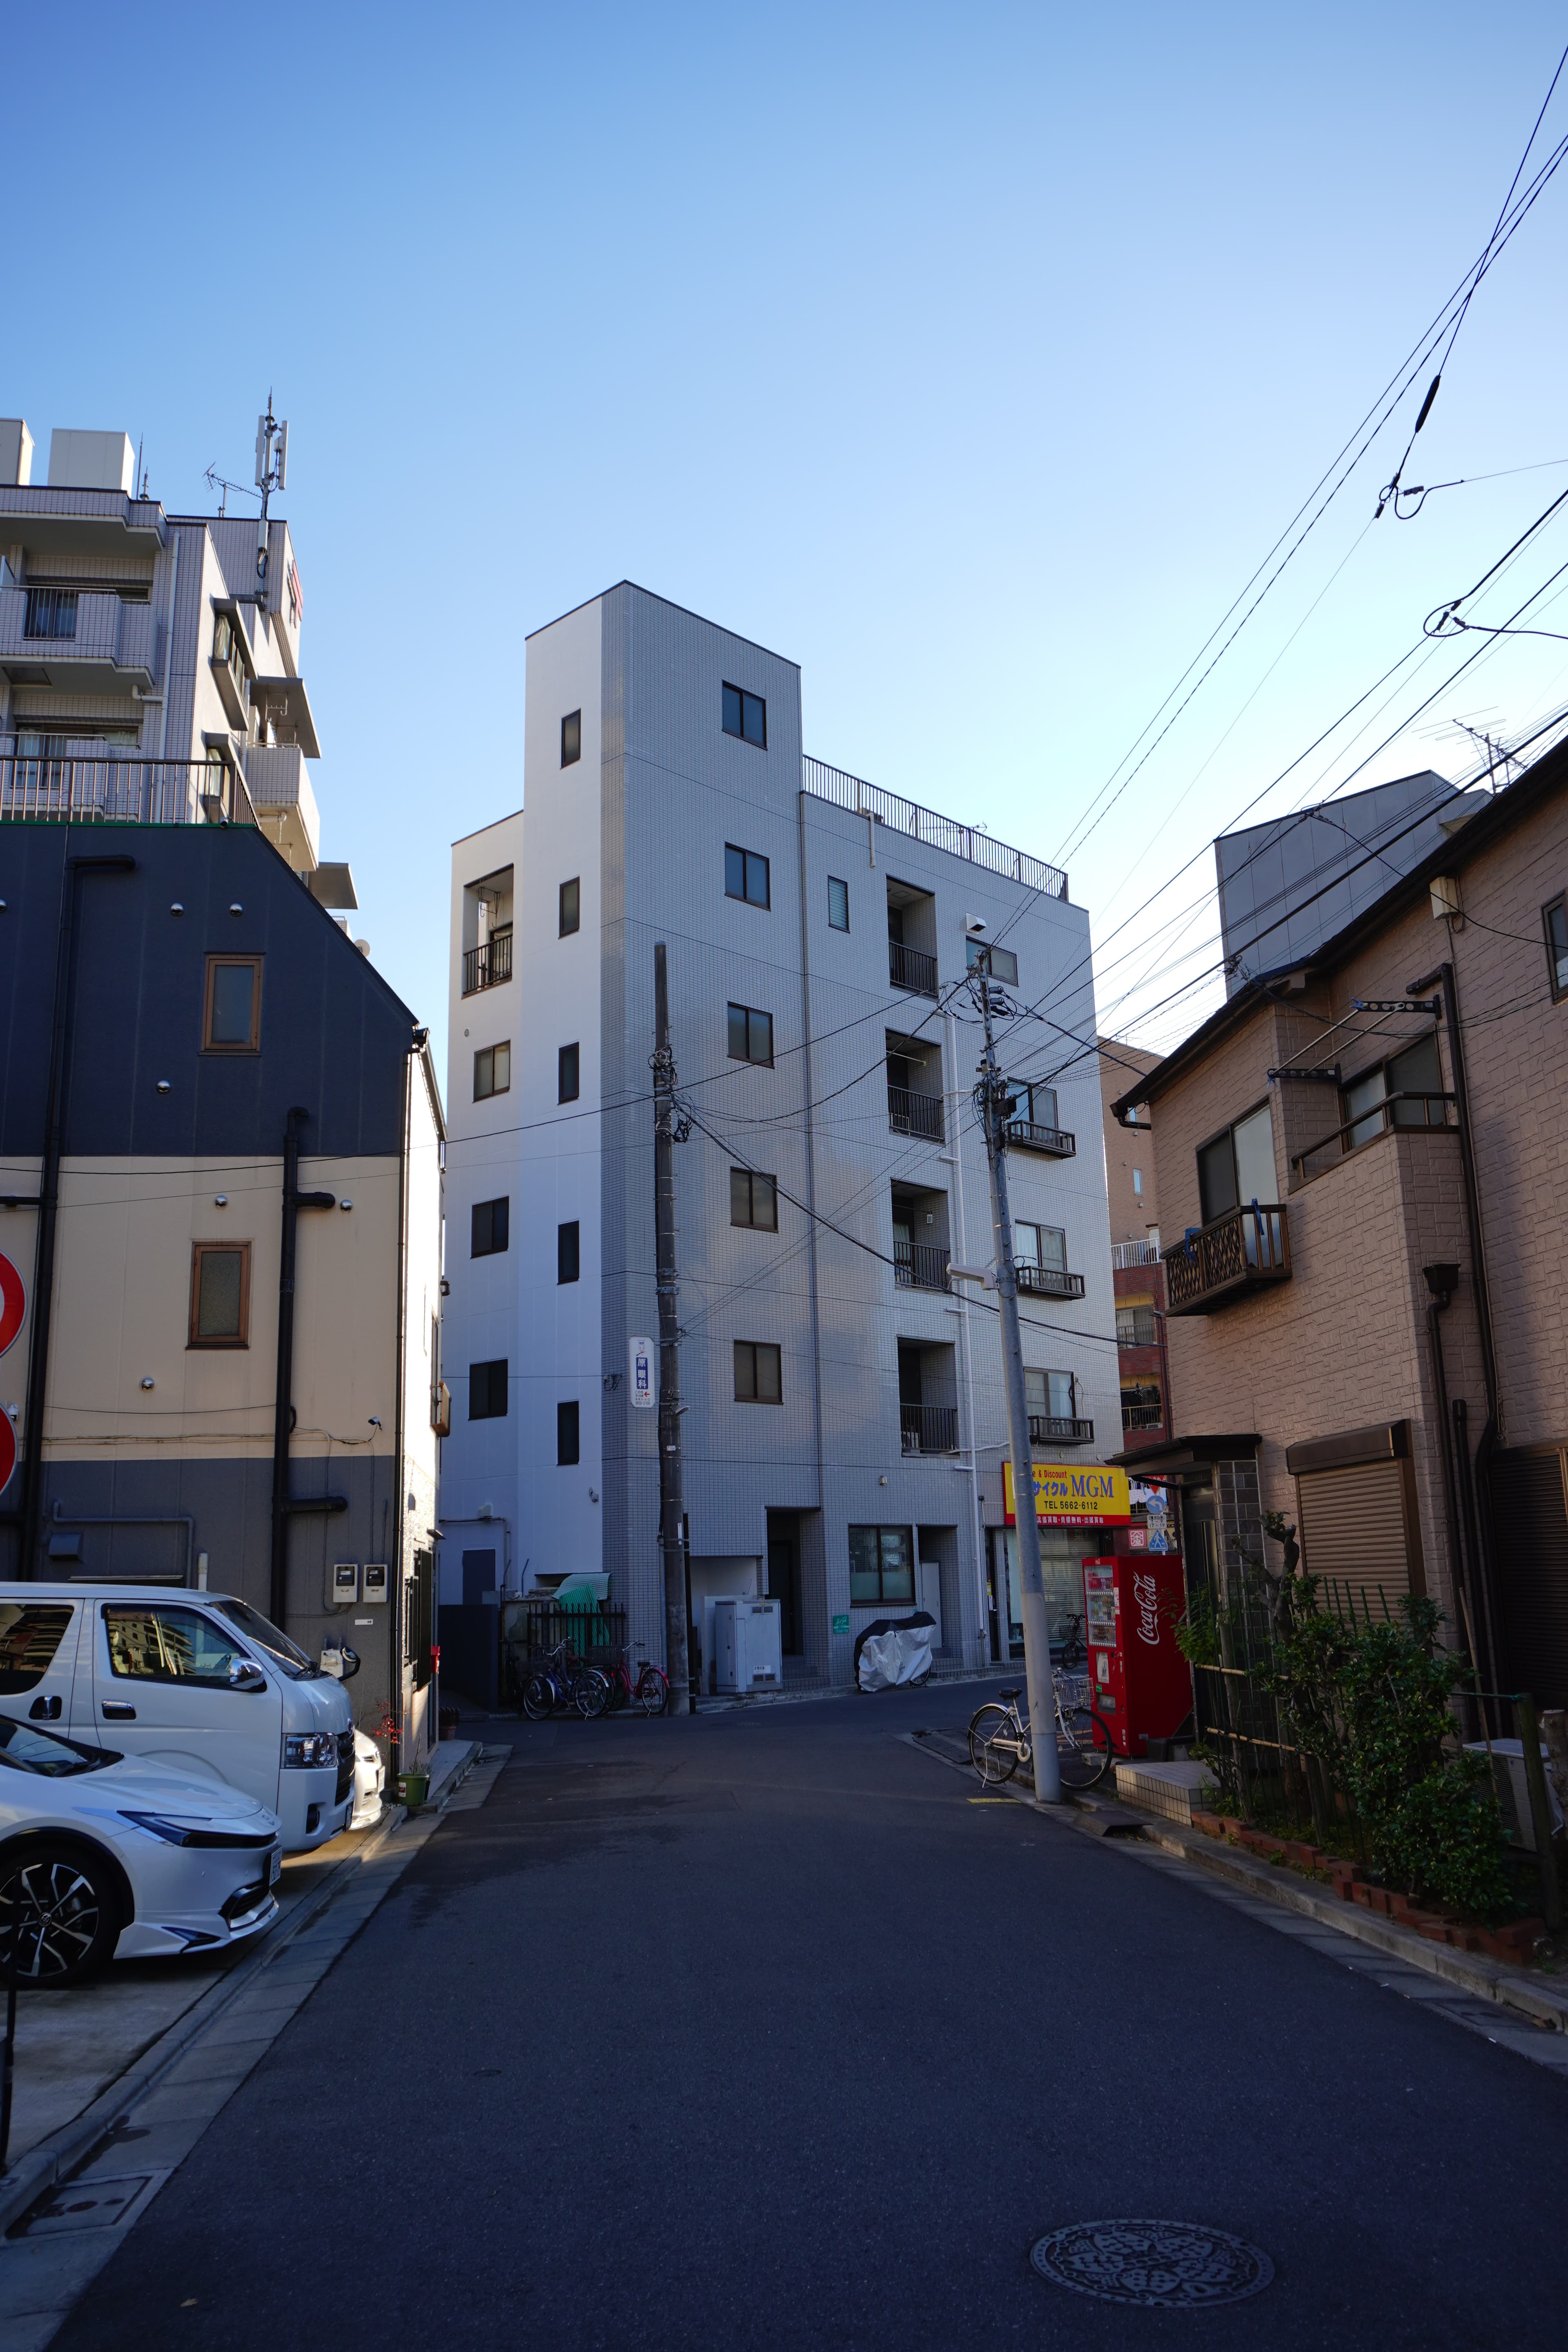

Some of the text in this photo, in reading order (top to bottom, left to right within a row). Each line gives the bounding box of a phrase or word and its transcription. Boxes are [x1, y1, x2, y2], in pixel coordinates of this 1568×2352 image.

[637, 1358, 646, 1388] 原眼科
[1044, 1470, 1067, 1479] Discount
[1070, 1474, 1114, 1498] MGM
[1044, 1501, 1098, 1510] TEL 5662-6112
[1133, 1571, 1160, 1645] Coca-Cola
